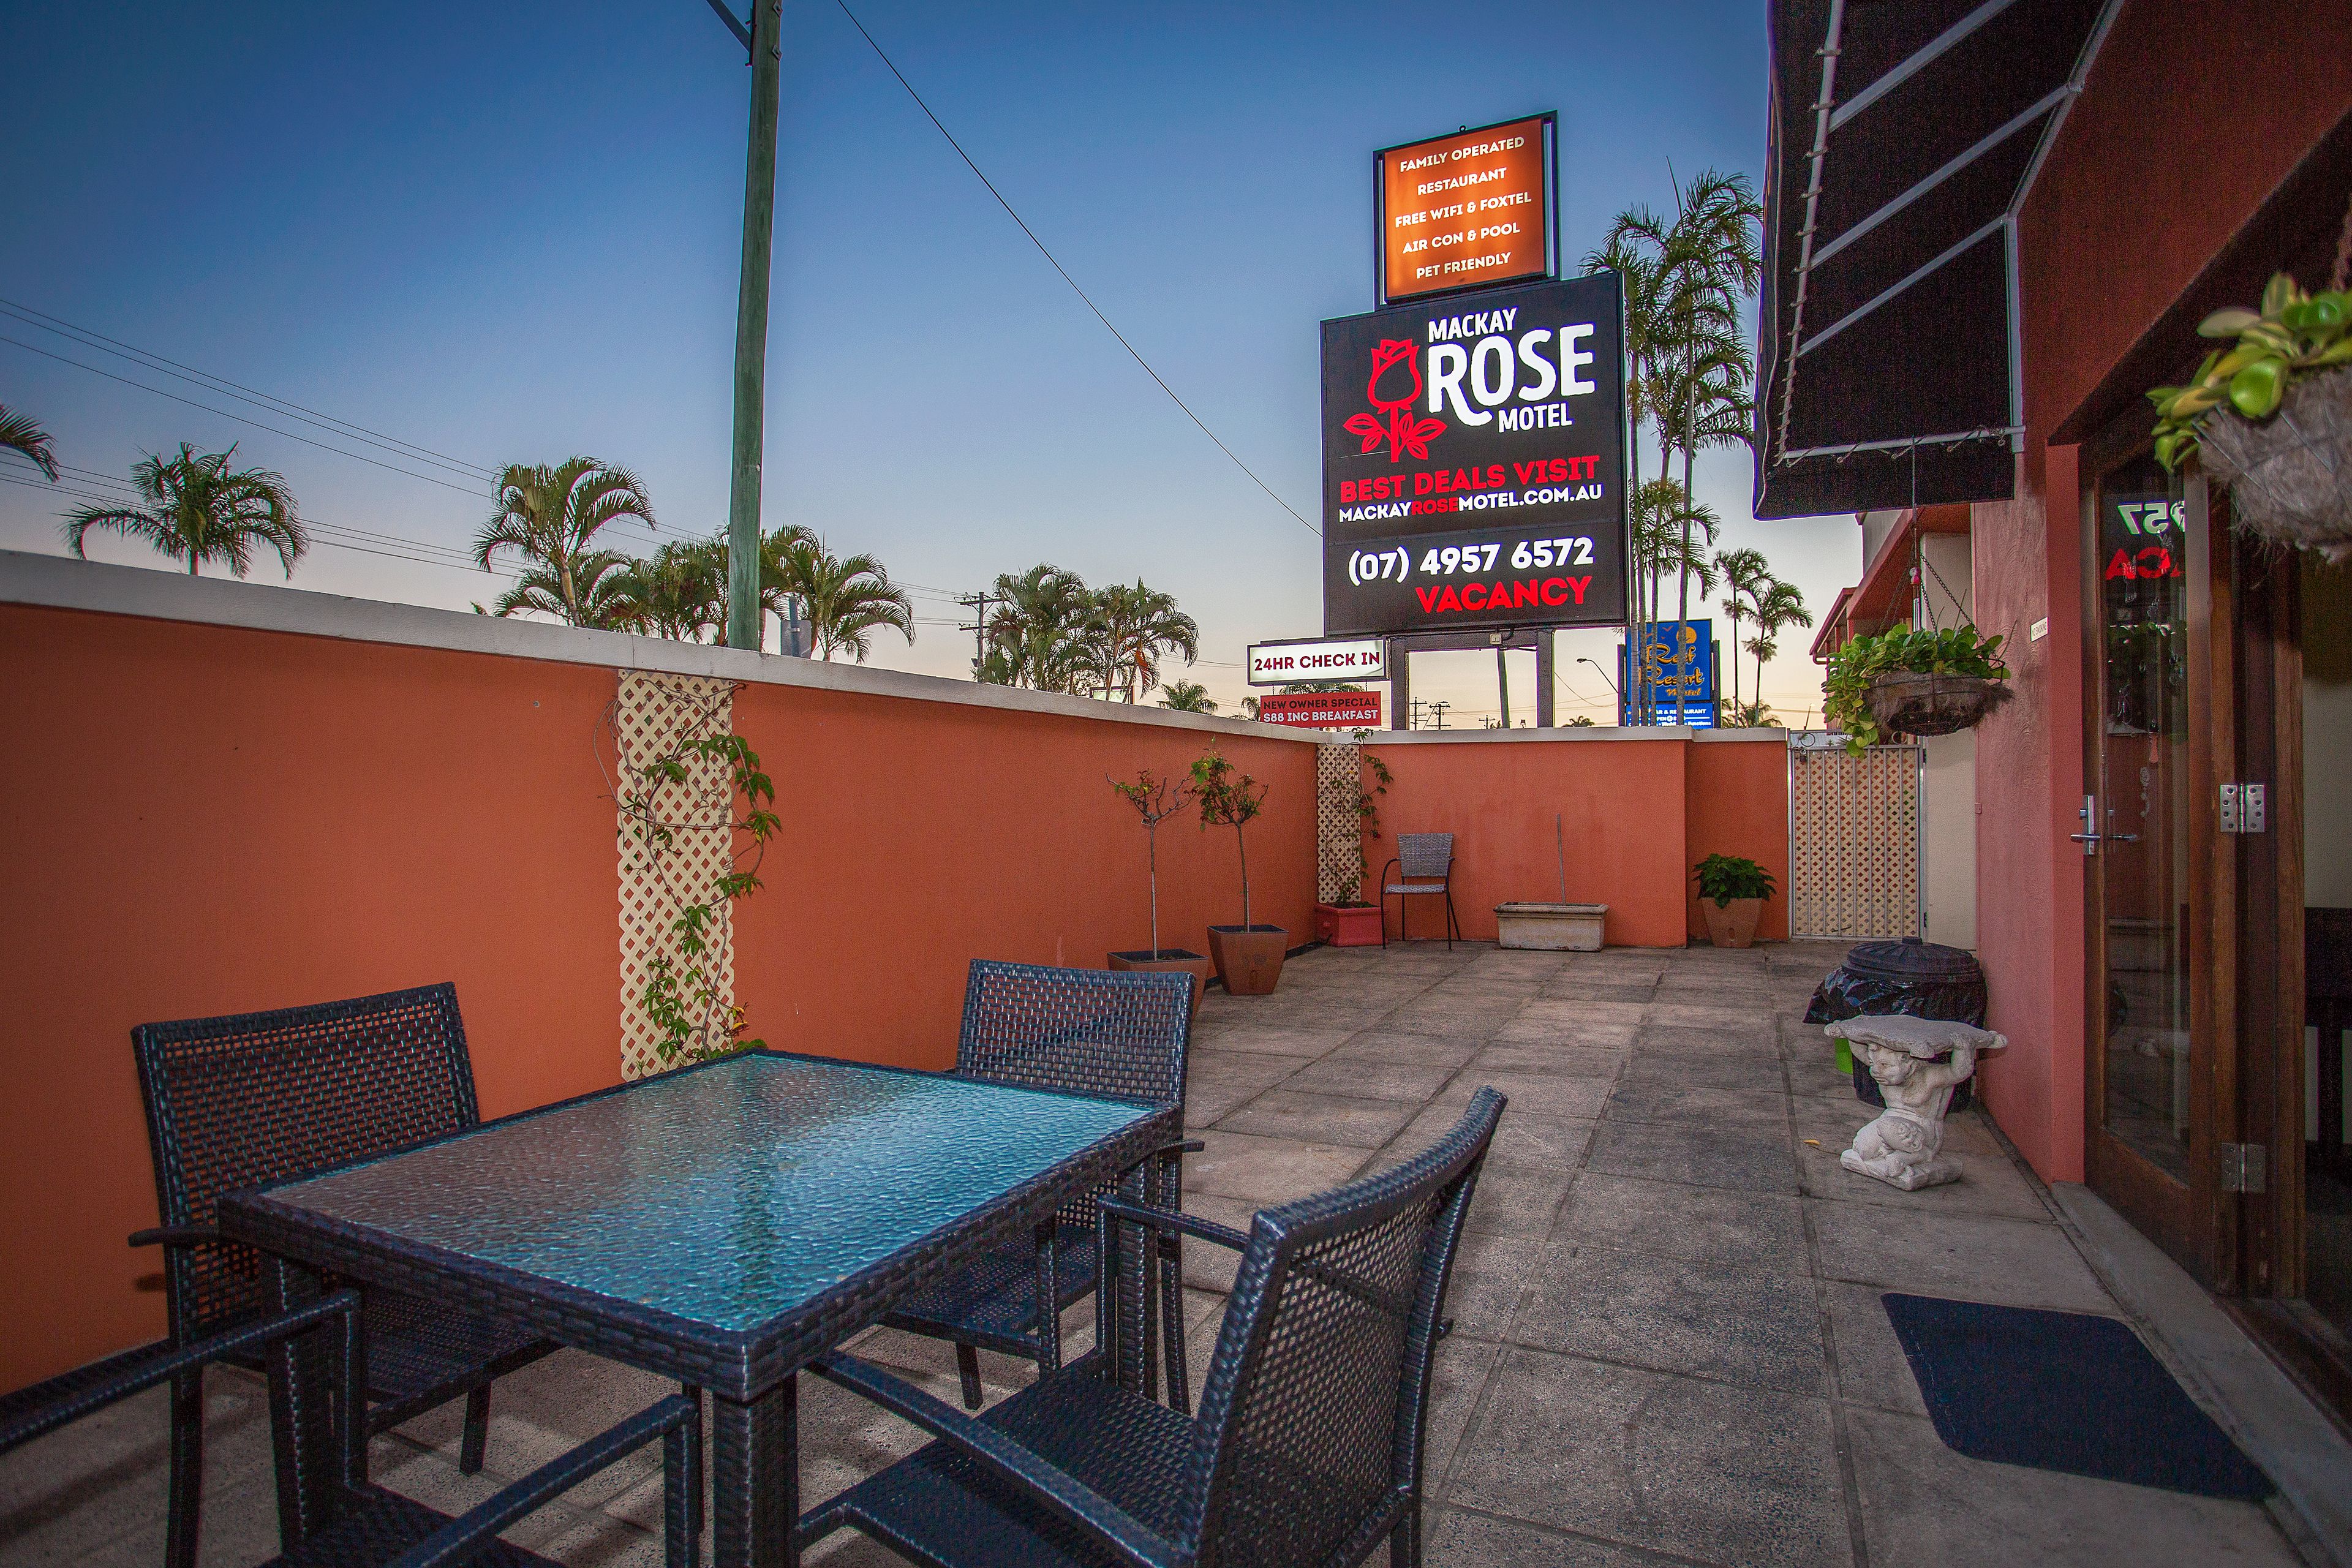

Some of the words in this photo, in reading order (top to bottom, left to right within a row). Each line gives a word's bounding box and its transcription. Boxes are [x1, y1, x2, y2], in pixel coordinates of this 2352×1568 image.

[1400, 152, 1448, 172] FAMILY
[1451, 137, 1525, 160] OPERATED
[1417, 168, 1507, 195] RESTAURANT
[1395, 211, 1427, 228] FREE
[1430, 204, 1463, 221] WIFI
[1467, 202, 1476, 213] &
[1480, 192, 1532, 211] FOXTEL
[1403, 239, 1428, 254] AIR
[1431, 232, 1463, 248] CON
[1467, 230, 1476, 241] &
[1480, 222, 1520, 239] POOL
[1416, 265, 1440, 279] PET
[1444, 252, 1511, 274] FRIENDLY
[1428, 307, 1518, 343] MACKAY
[1428, 323, 1596, 427] ROSE
[1498, 402, 1572, 433] MOTEL
[1340, 475, 1406, 503] BEST
[1415, 464, 1506, 496] DEALS
[1513, 455, 1600, 483] VISIT
[1338, 484, 1602, 522] MACKAYROSEMOTEL.COM.AU
[1348, 546, 1409, 587] (07)
[1419, 543, 1501, 575] 4957
[1510, 537, 1594, 568] 6572
[1415, 575, 1593, 614] VACANCY
[1254, 657, 1294, 671] 24HR
[1300, 653, 1356, 669] CHECK
[1362, 651, 1380, 665] IN
[1264, 700, 1286, 710] NEW
[1289, 699, 1328, 709] OWNER
[1331, 697, 1378, 707] SPECIAL
[1264, 712, 1284, 723] $88
[1287, 711, 1309, 722] INC
[1312, 709, 1378, 721] BREAKFAST
